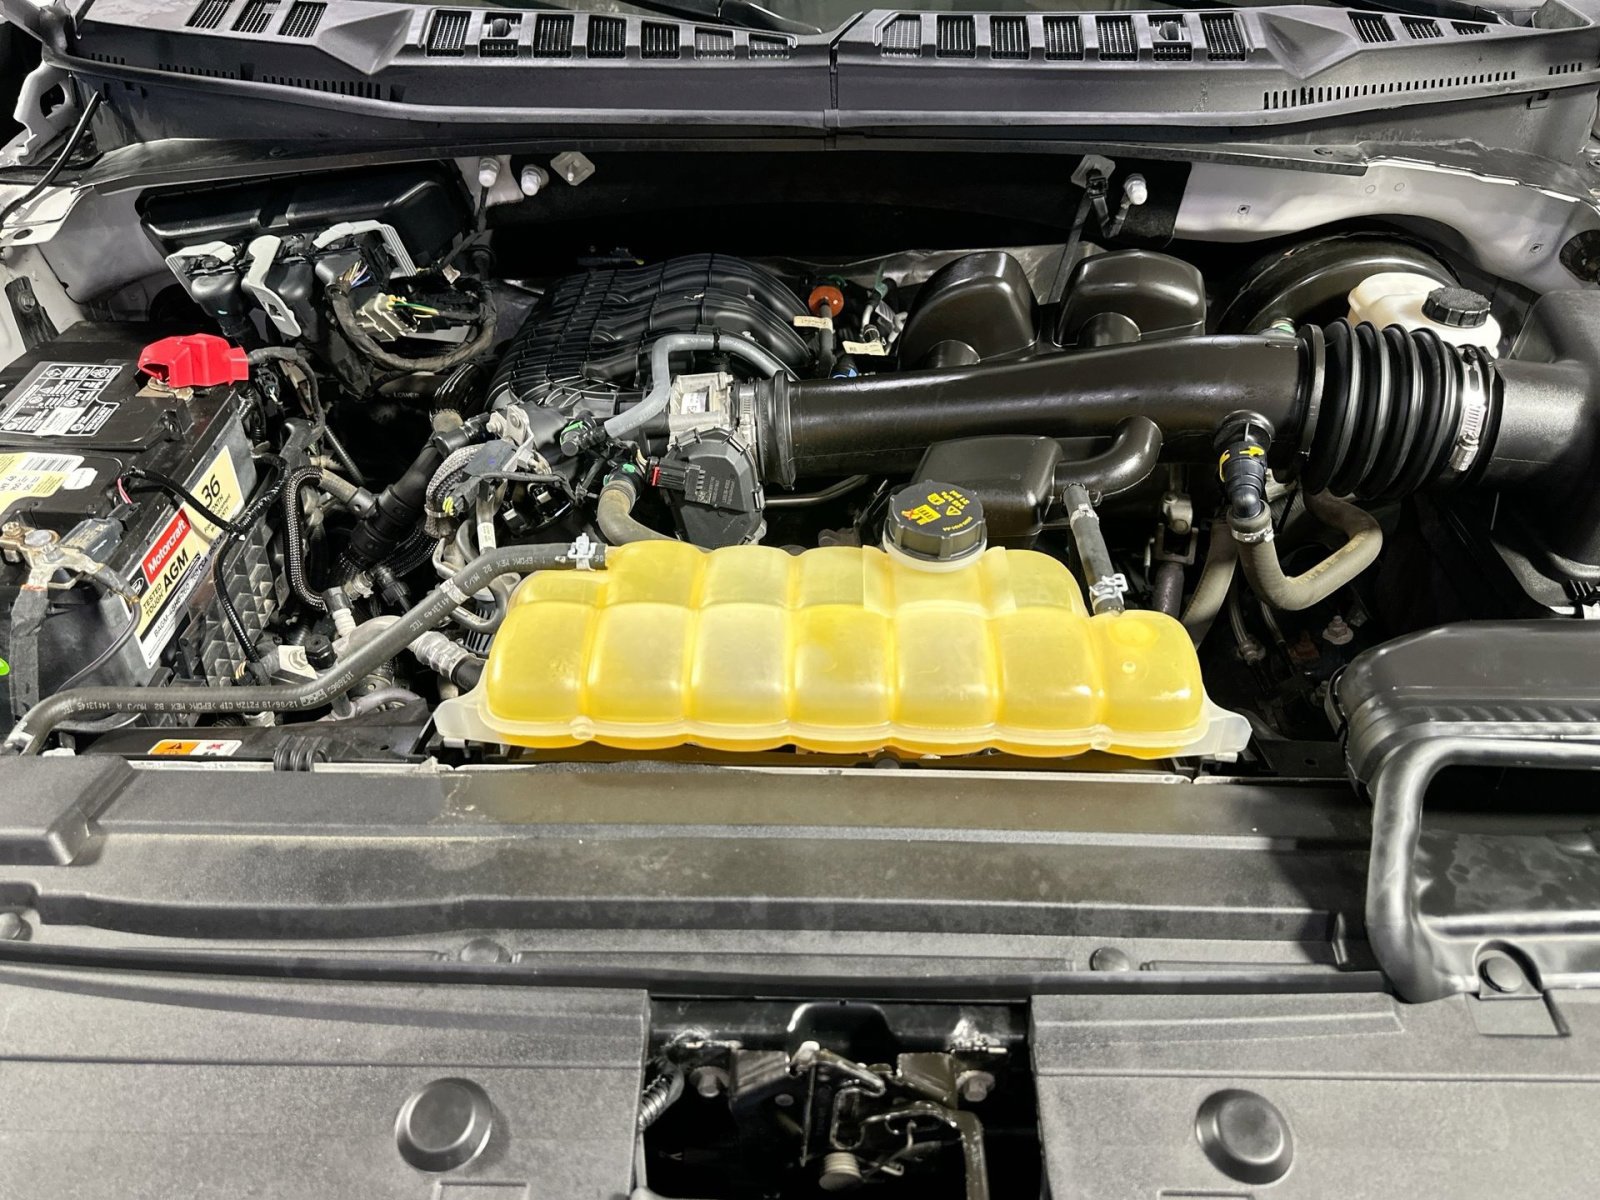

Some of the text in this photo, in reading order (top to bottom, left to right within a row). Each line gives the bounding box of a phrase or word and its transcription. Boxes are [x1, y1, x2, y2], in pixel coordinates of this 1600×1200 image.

[201, 474, 221, 508] 36
[147, 519, 187, 575] Motorcraft
[163, 548, 189, 593] AGM
[143, 583, 162, 611] TESTED
